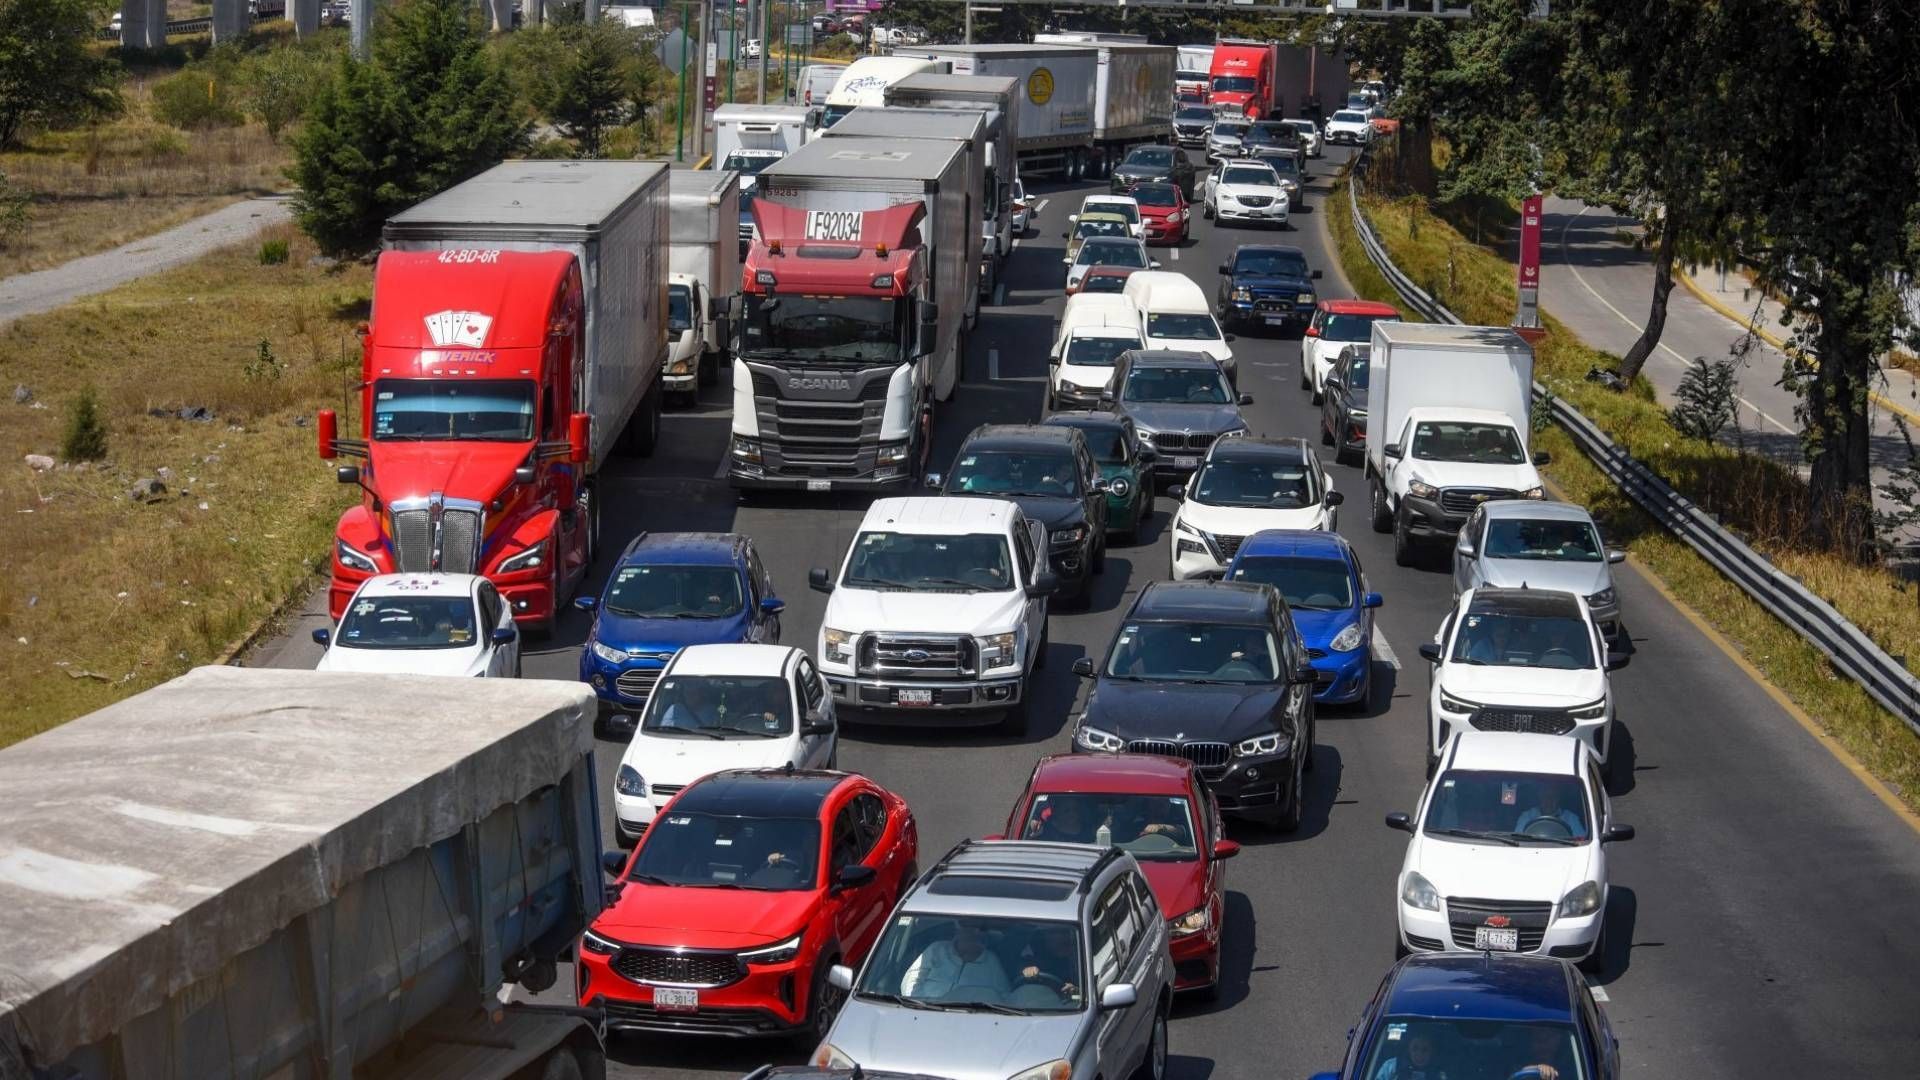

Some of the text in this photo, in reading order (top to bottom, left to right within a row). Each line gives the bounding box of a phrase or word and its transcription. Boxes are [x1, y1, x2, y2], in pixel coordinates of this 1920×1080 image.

[806, 211, 861, 241] LF92034
[438, 249, 500, 264] 42-BD-6R
[413, 350, 496, 364] VERICK
[788, 378, 850, 390] SCANIA
